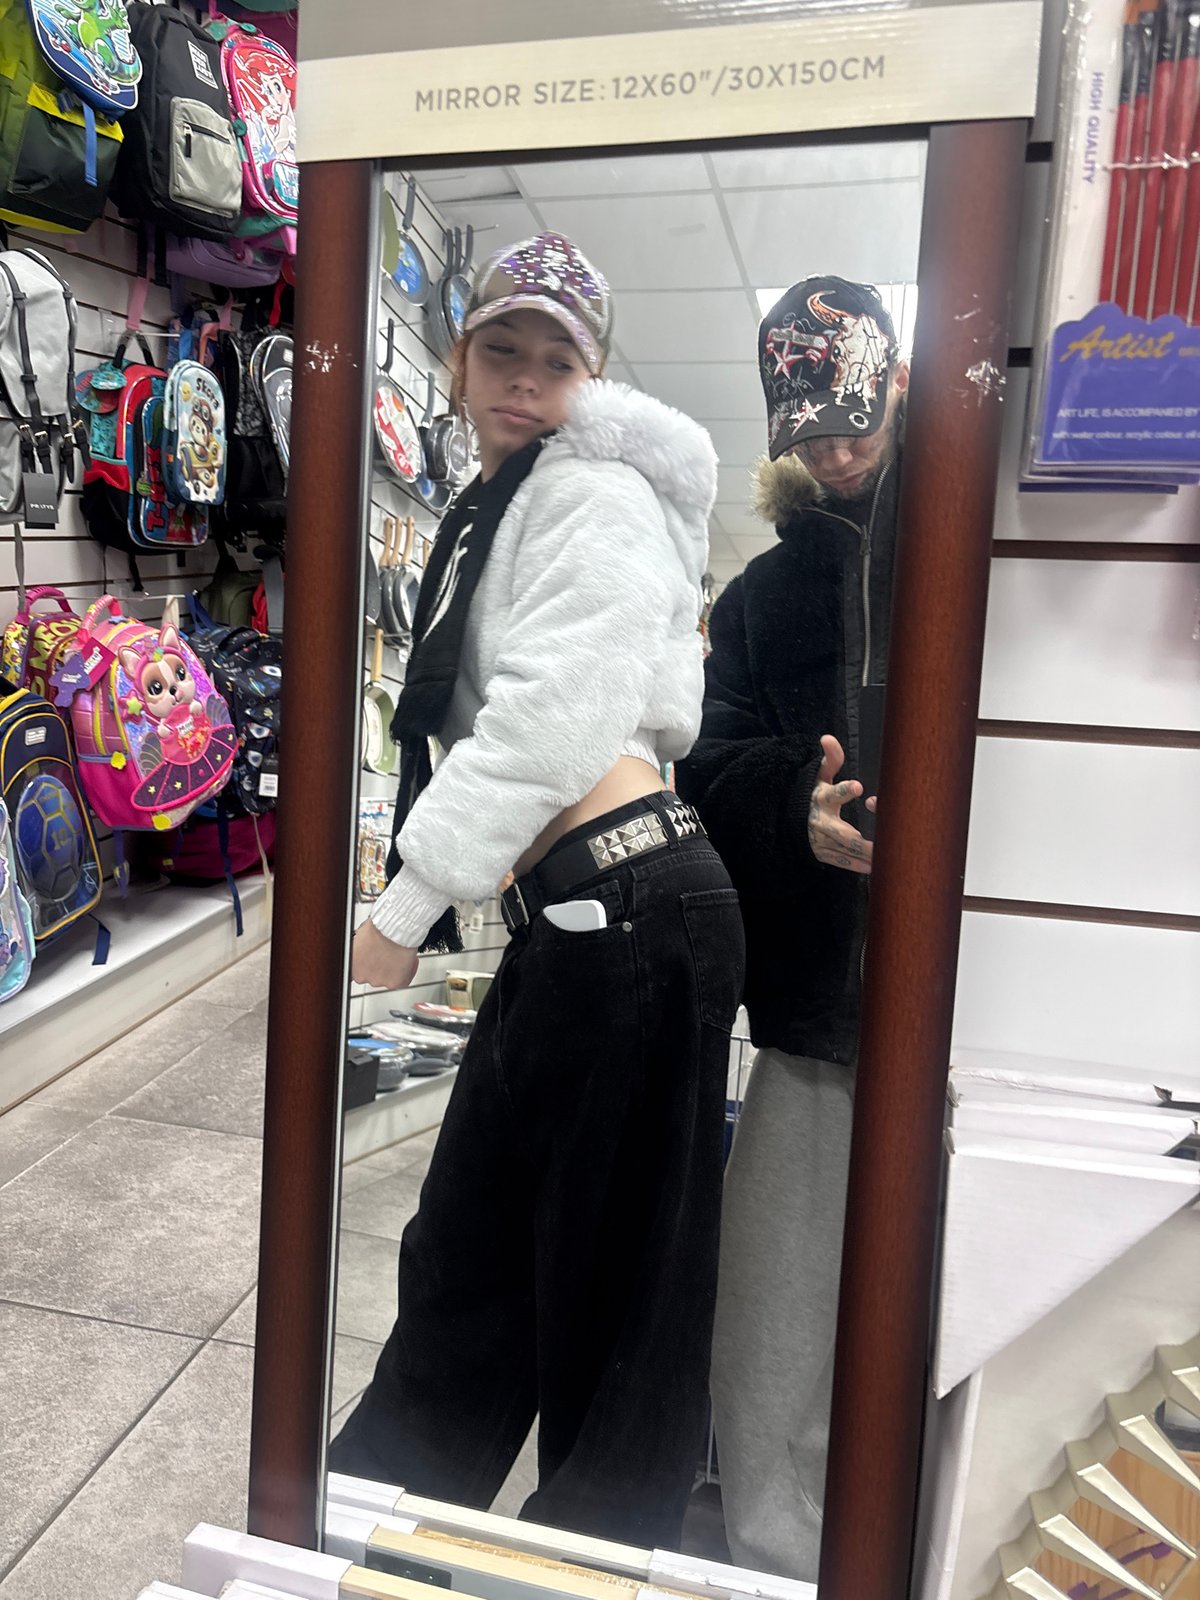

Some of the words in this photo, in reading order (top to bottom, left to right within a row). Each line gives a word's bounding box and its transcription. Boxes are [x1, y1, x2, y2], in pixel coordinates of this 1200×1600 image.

[415, 84, 521, 112] MIRROR
[1090, 72, 1104, 110] HIGH
[1082, 116, 1100, 184] QUALITY
[1059, 325, 1175, 363] Artist
[1057, 408, 1077, 418] ART
[52, 828, 68, 850] 10
